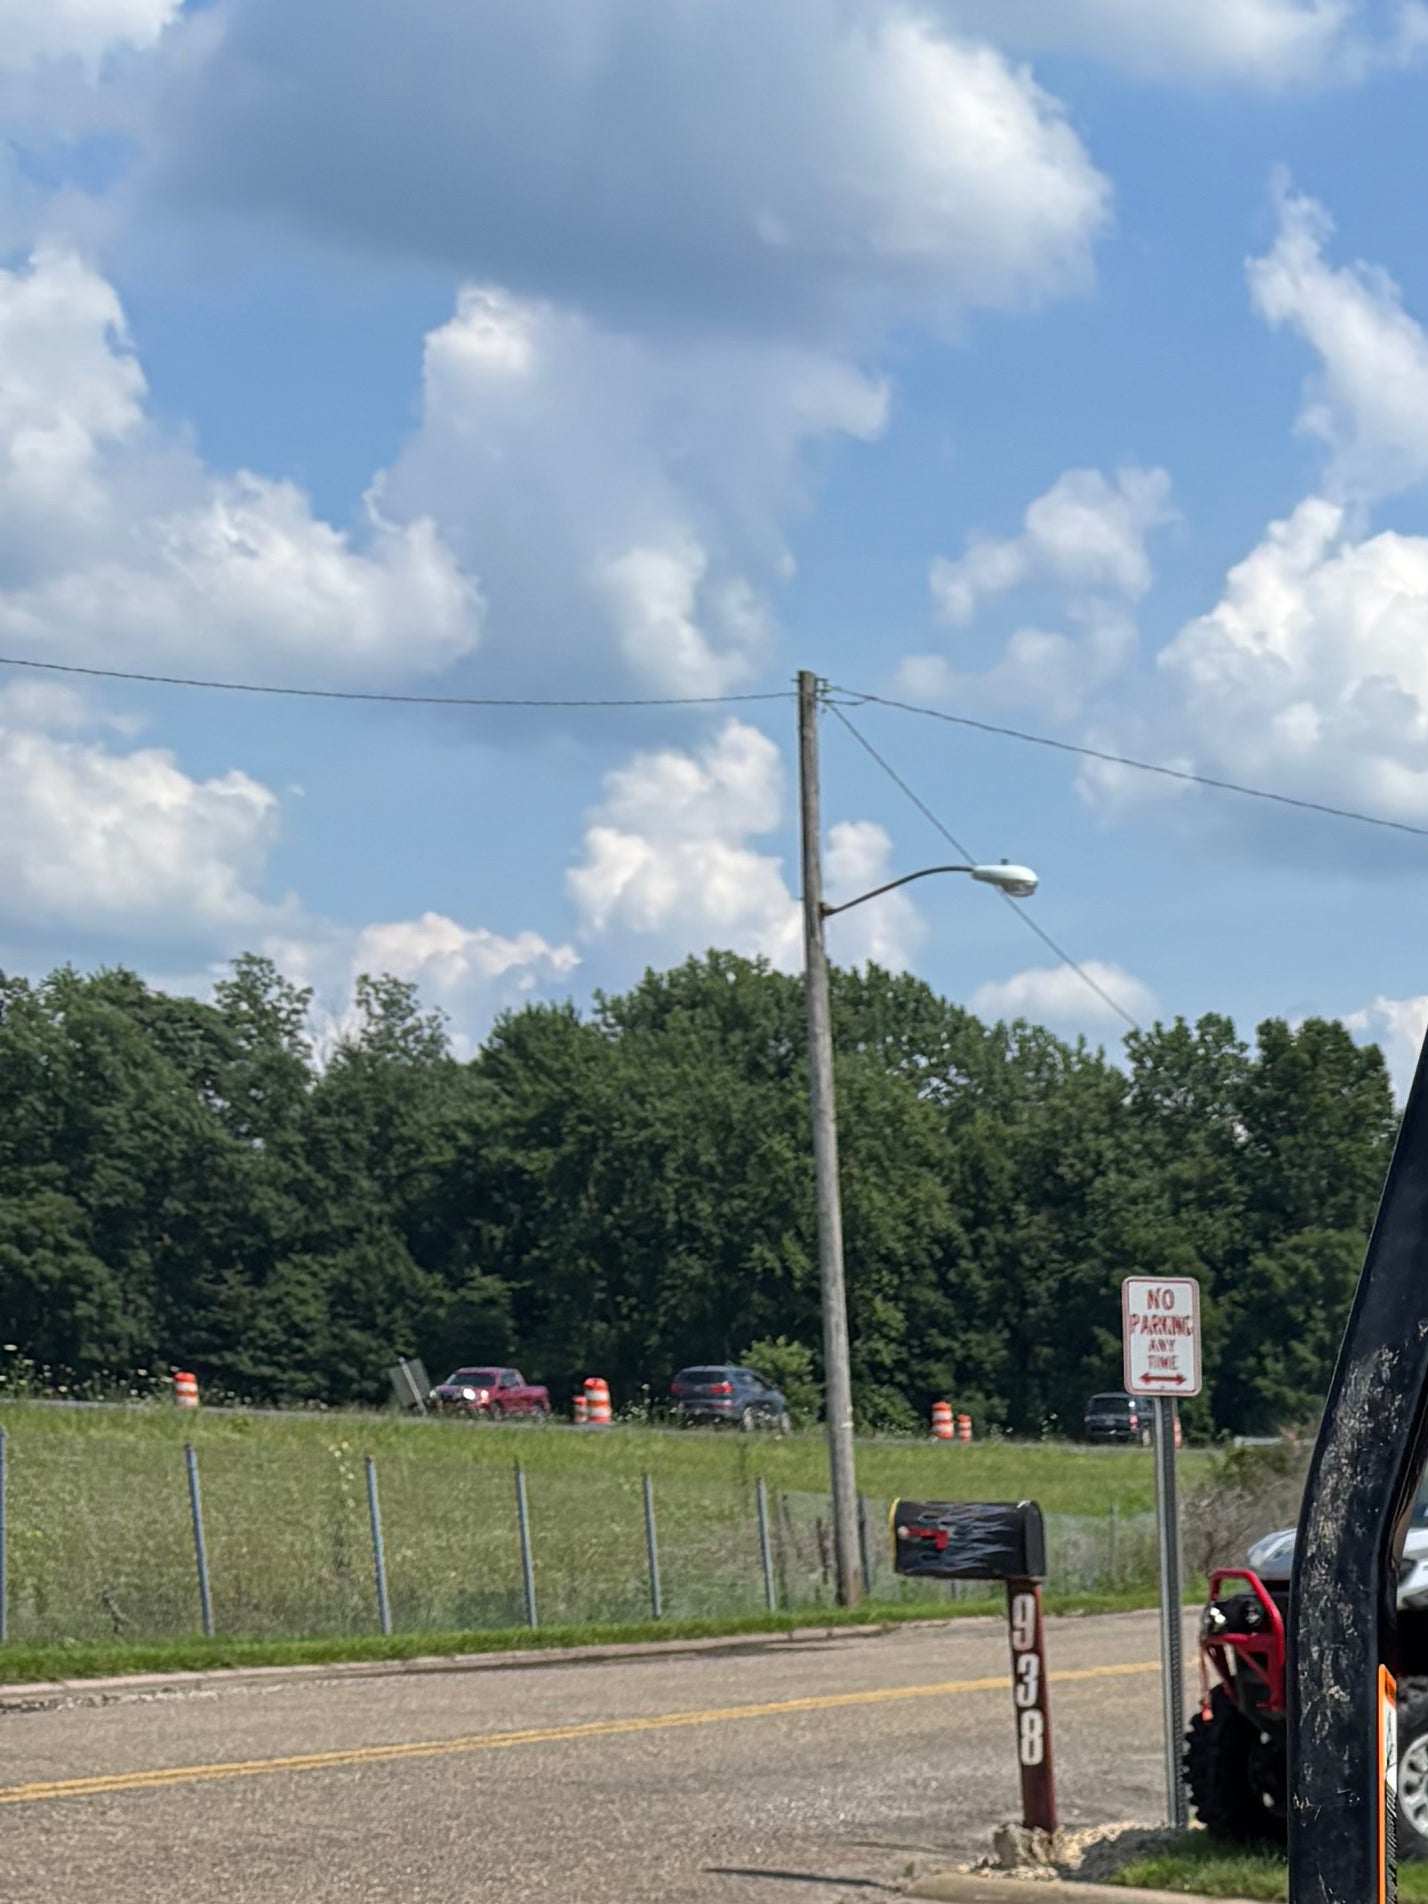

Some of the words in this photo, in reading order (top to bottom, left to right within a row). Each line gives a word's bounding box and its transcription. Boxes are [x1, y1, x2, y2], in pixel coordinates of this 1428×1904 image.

[1146, 1288, 1175, 1310] NO
[1128, 1314, 1193, 1336] PARKING
[1149, 1339, 1175, 1352] ANY
[1147, 1355, 1178, 1370] TIME
[1012, 1593, 1044, 1766] 938
